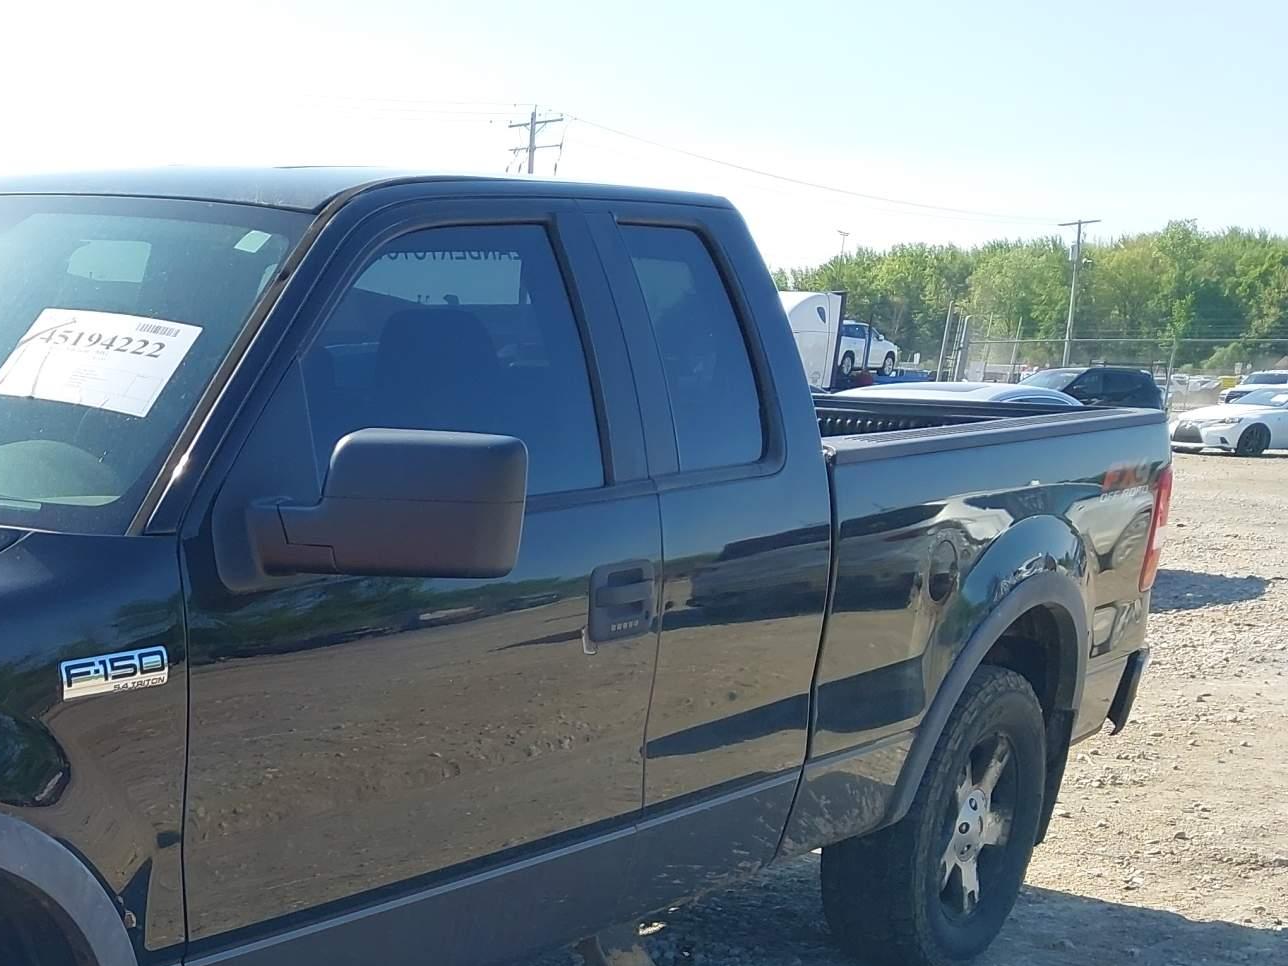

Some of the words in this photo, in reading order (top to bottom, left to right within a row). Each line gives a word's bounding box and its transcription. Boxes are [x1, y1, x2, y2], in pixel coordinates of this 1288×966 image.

[39, 328, 168, 359] 45194222
[65, 650, 166, 688] F-150
[130, 676, 165, 690] TRITON
